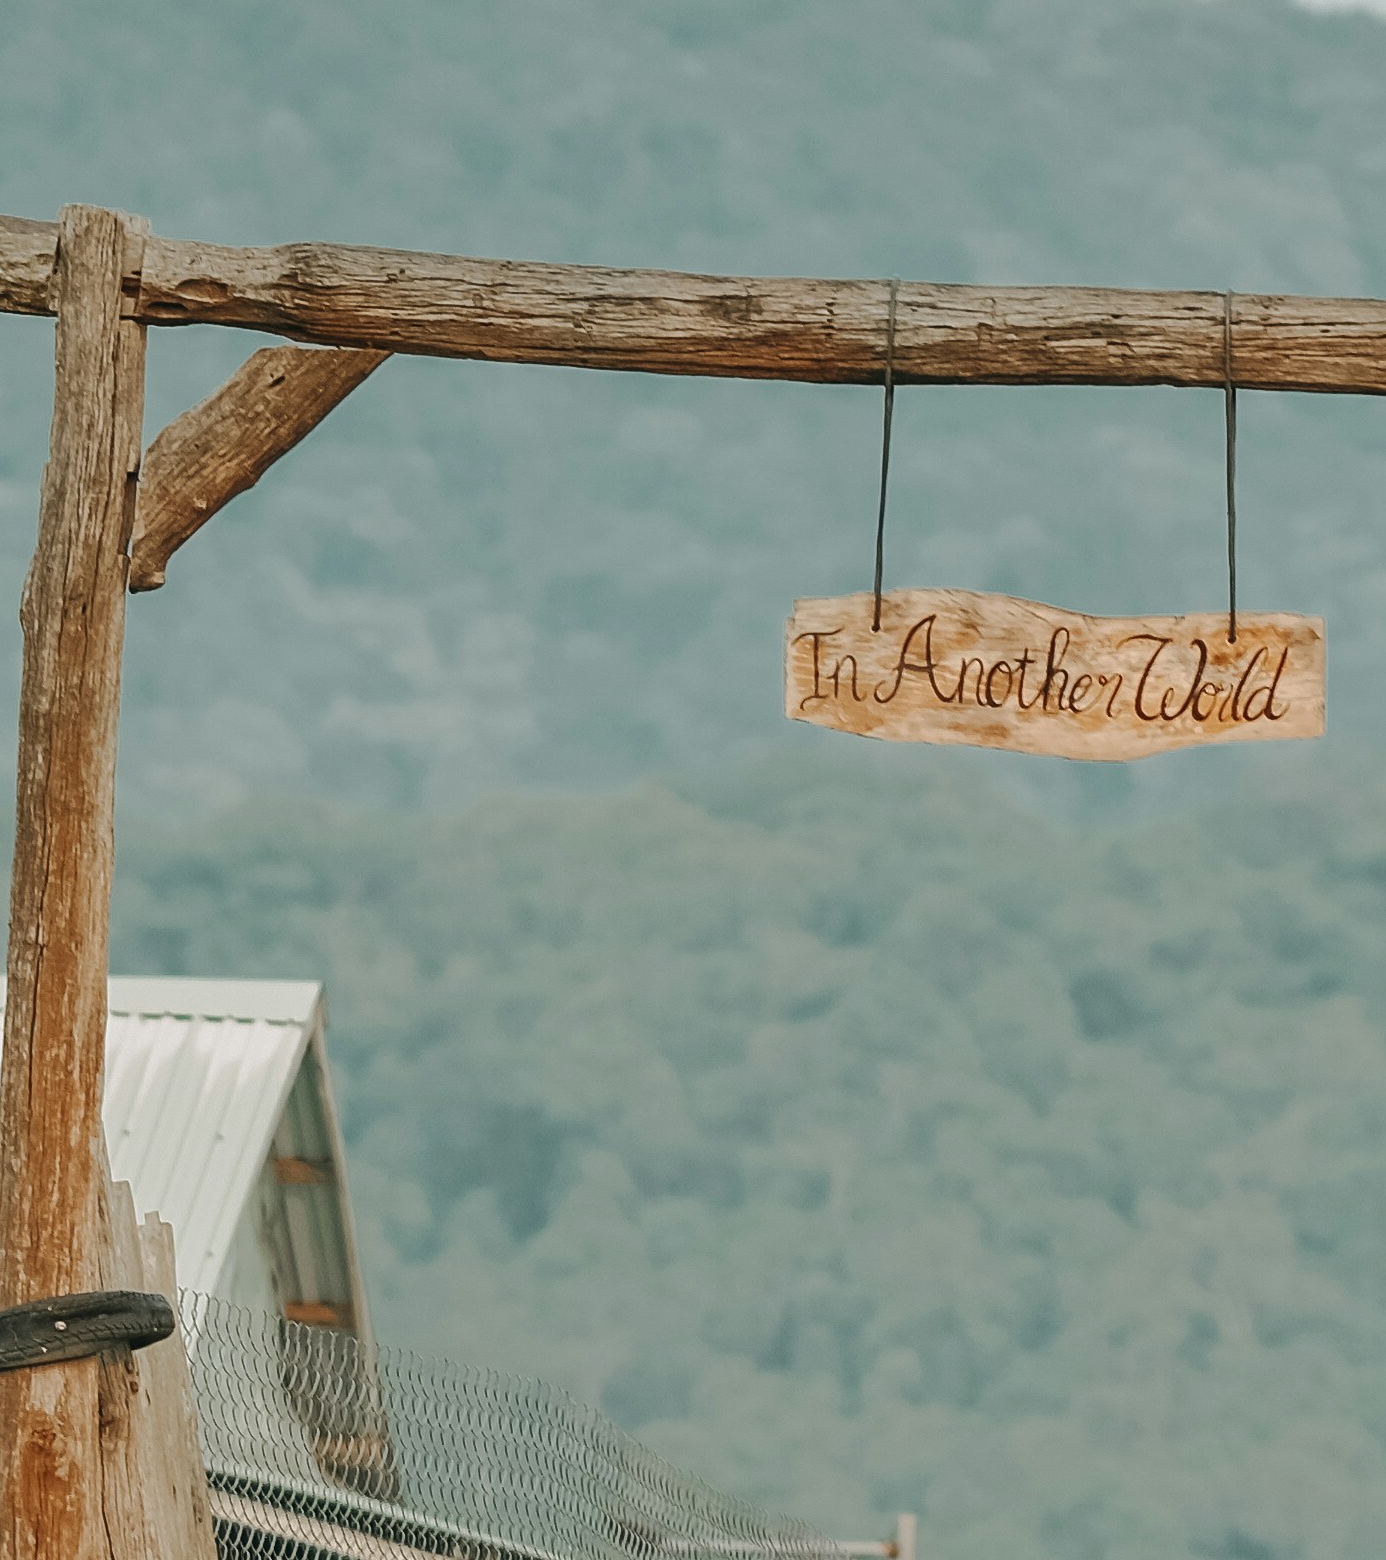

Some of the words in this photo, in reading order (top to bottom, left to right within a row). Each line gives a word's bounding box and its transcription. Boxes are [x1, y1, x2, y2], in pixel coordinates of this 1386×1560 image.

[792, 628, 866, 711] In
[873, 613, 1124, 718] Another
[1117, 633, 1289, 722] World
